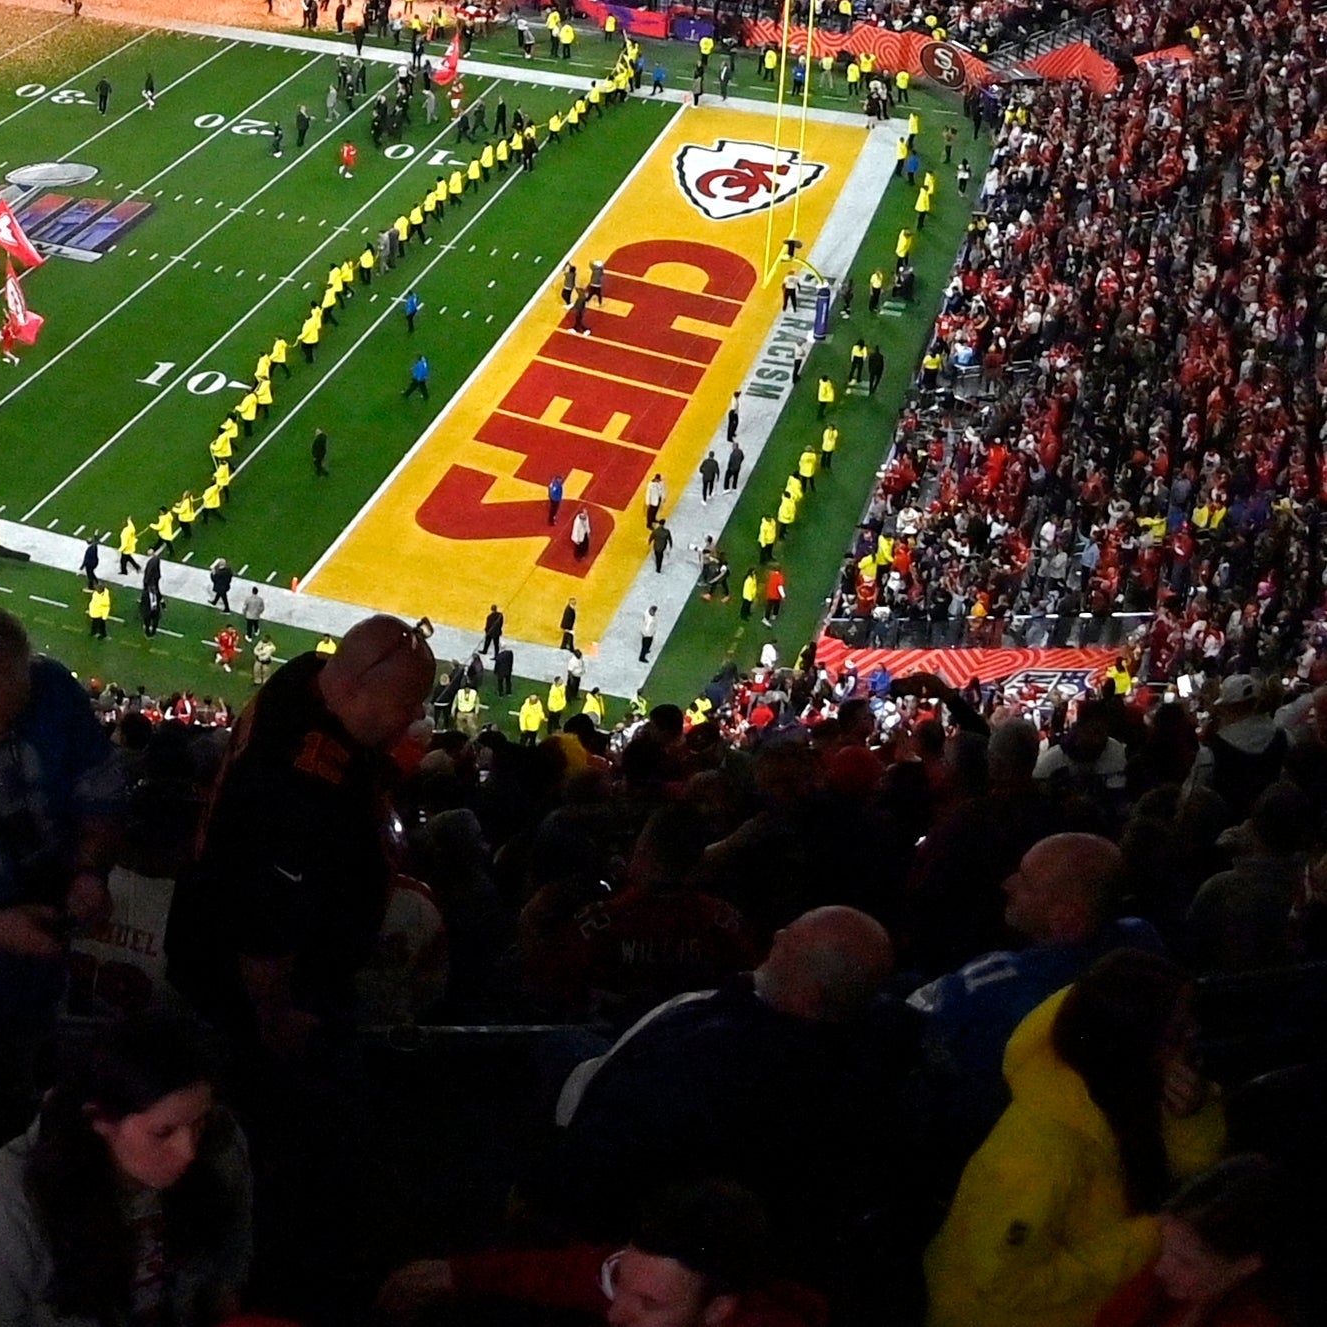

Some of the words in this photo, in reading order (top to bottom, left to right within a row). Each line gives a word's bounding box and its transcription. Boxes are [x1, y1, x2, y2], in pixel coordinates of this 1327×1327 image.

[15, 83, 86, 104] 30
[193, 113, 271, 136] 20
[383, 143, 457, 166] 10
[696, 159, 790, 203] KC
[745, 316, 815, 401] RACISM
[135, 360, 227, 395] 10
[414, 239, 758, 579] CHIEFS
